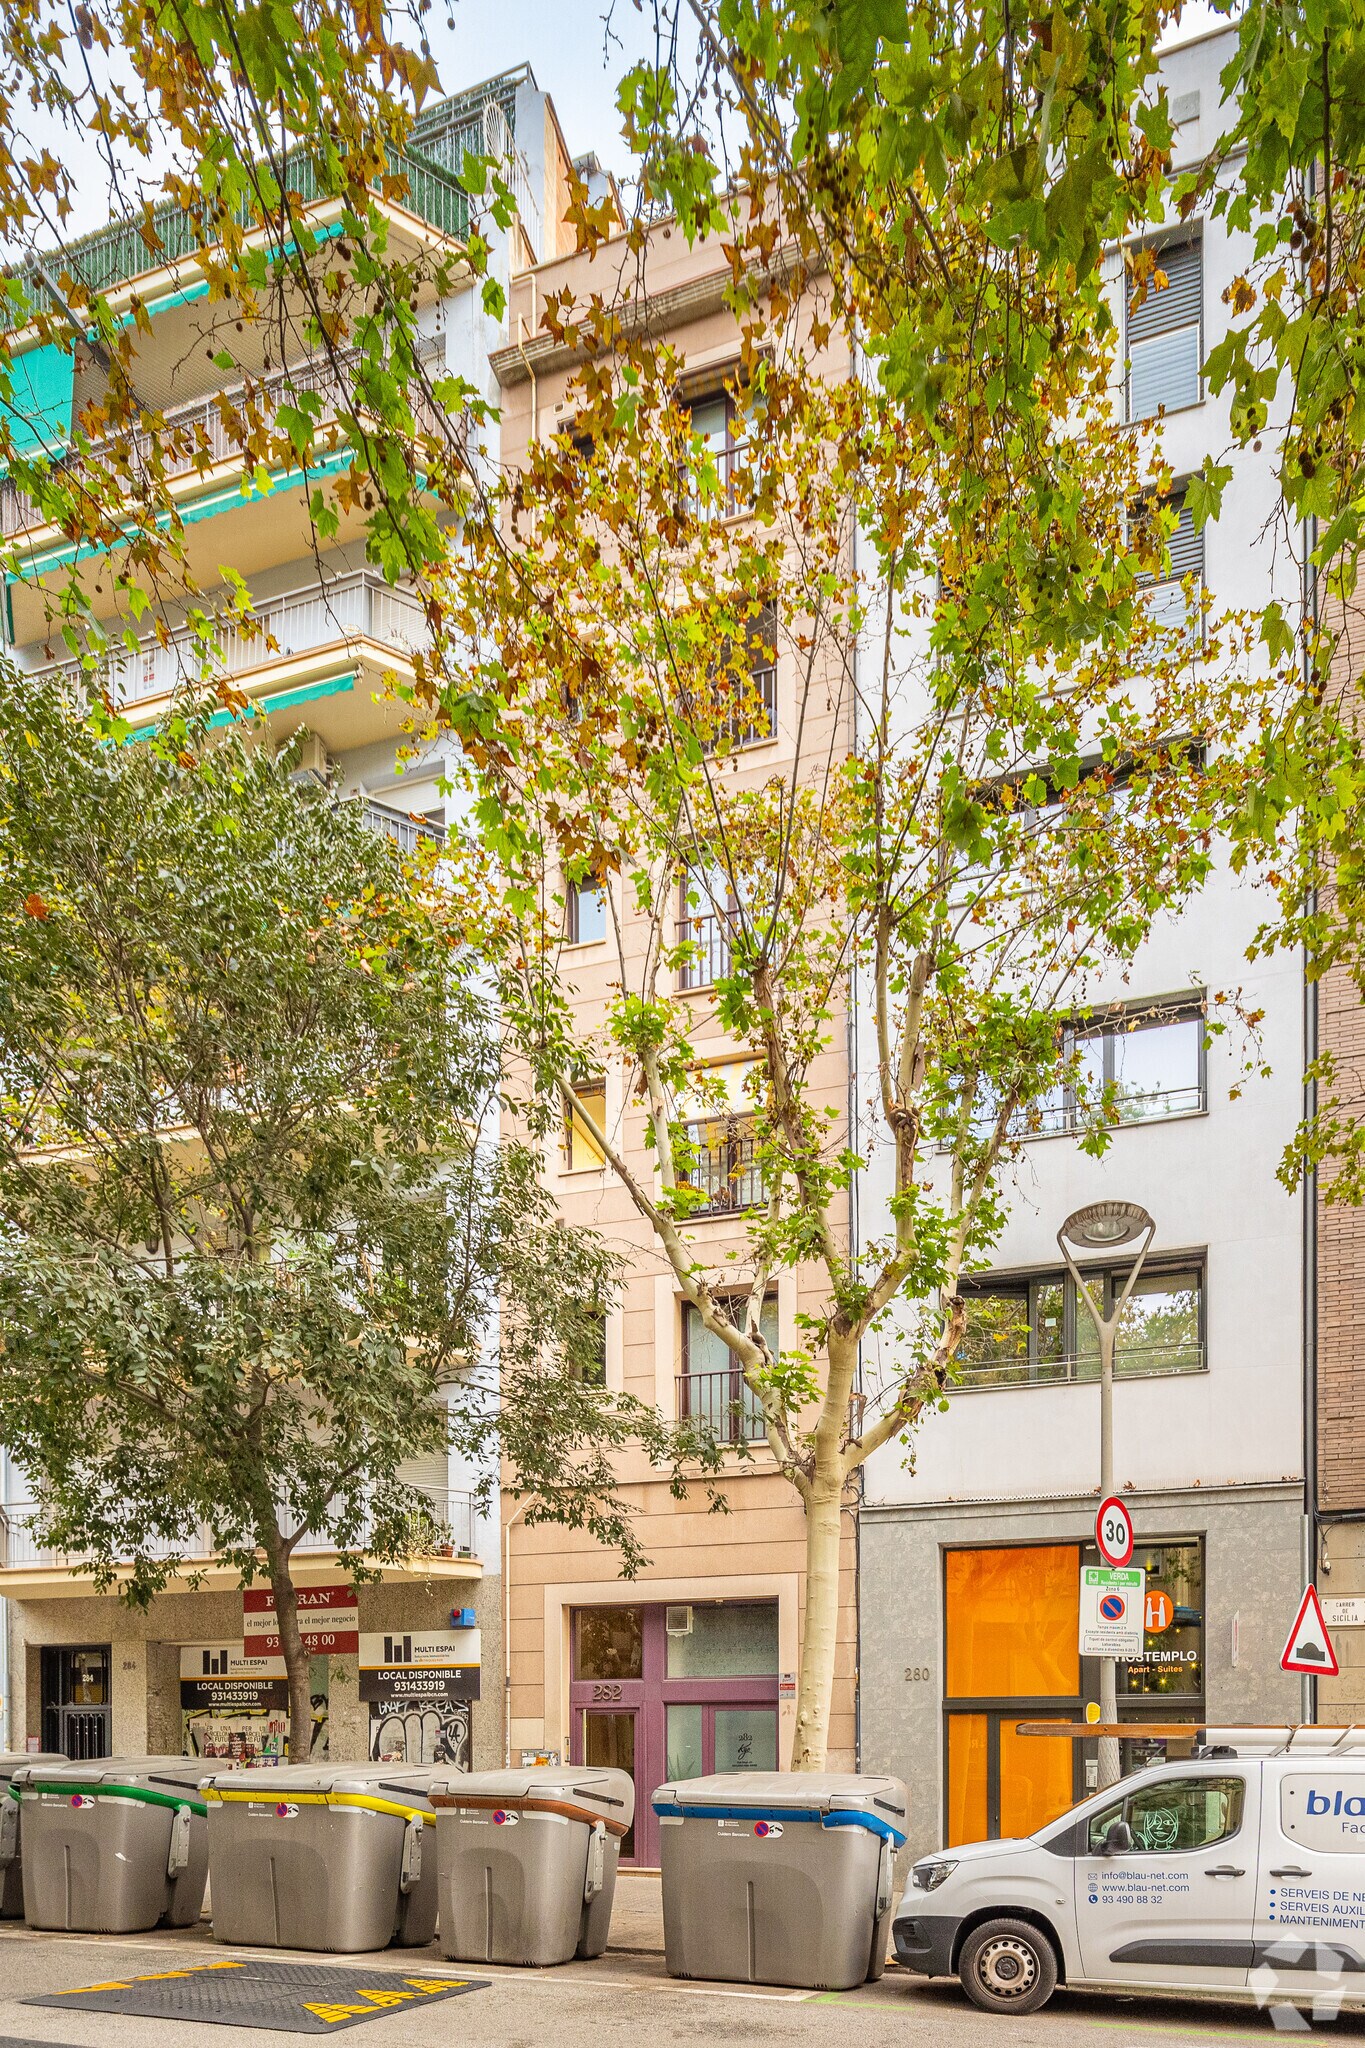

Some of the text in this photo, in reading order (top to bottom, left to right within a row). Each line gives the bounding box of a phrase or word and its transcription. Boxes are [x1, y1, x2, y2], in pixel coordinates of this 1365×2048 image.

[1106, 1520, 1125, 1545] 30
[1110, 1572, 1129, 1581] VERDA
[247, 1619, 252, 1627] el
[254, 1619, 271, 1628] mejor
[305, 1617, 310, 1625] el
[312, 1615, 330, 1625] mejor
[332, 1614, 356, 1624] negocio
[266, 1637, 279, 1648] 93
[305, 1635, 318, 1646] 48
[321, 1634, 335, 1645] 00
[122, 1661, 137, 1670] 284
[1128, 1665, 1150, 1674] Apart
[1157, 1665, 1183, 1673] Suites
[82, 1674, 94, 1682] 284
[378, 1669, 461, 1680] LOCAL DISPONIBLE
[905, 1668, 930, 1681] 280
[197, 1681, 273, 1691] LOCAL DISPONIBLE
[394, 1680, 445, 1691] 931433919
[211, 1691, 258, 1701] 931433919
[592, 1684, 622, 1701] 282
[739, 1733, 752, 1741] 282
[1101, 1871, 1189, 1880] info@blau-net.com
[1102, 1884, 1190, 1892] www.blau-net.com
[1102, 1895, 1163, 1904] 93 490 88 32
[1280, 1888, 1329, 1900] SERVEIS
[1333, 1891, 1349, 1901] DE
[1280, 1901, 1329, 1913] SERVEIS
[1279, 1914, 1365, 1929] MANTENIMENT
